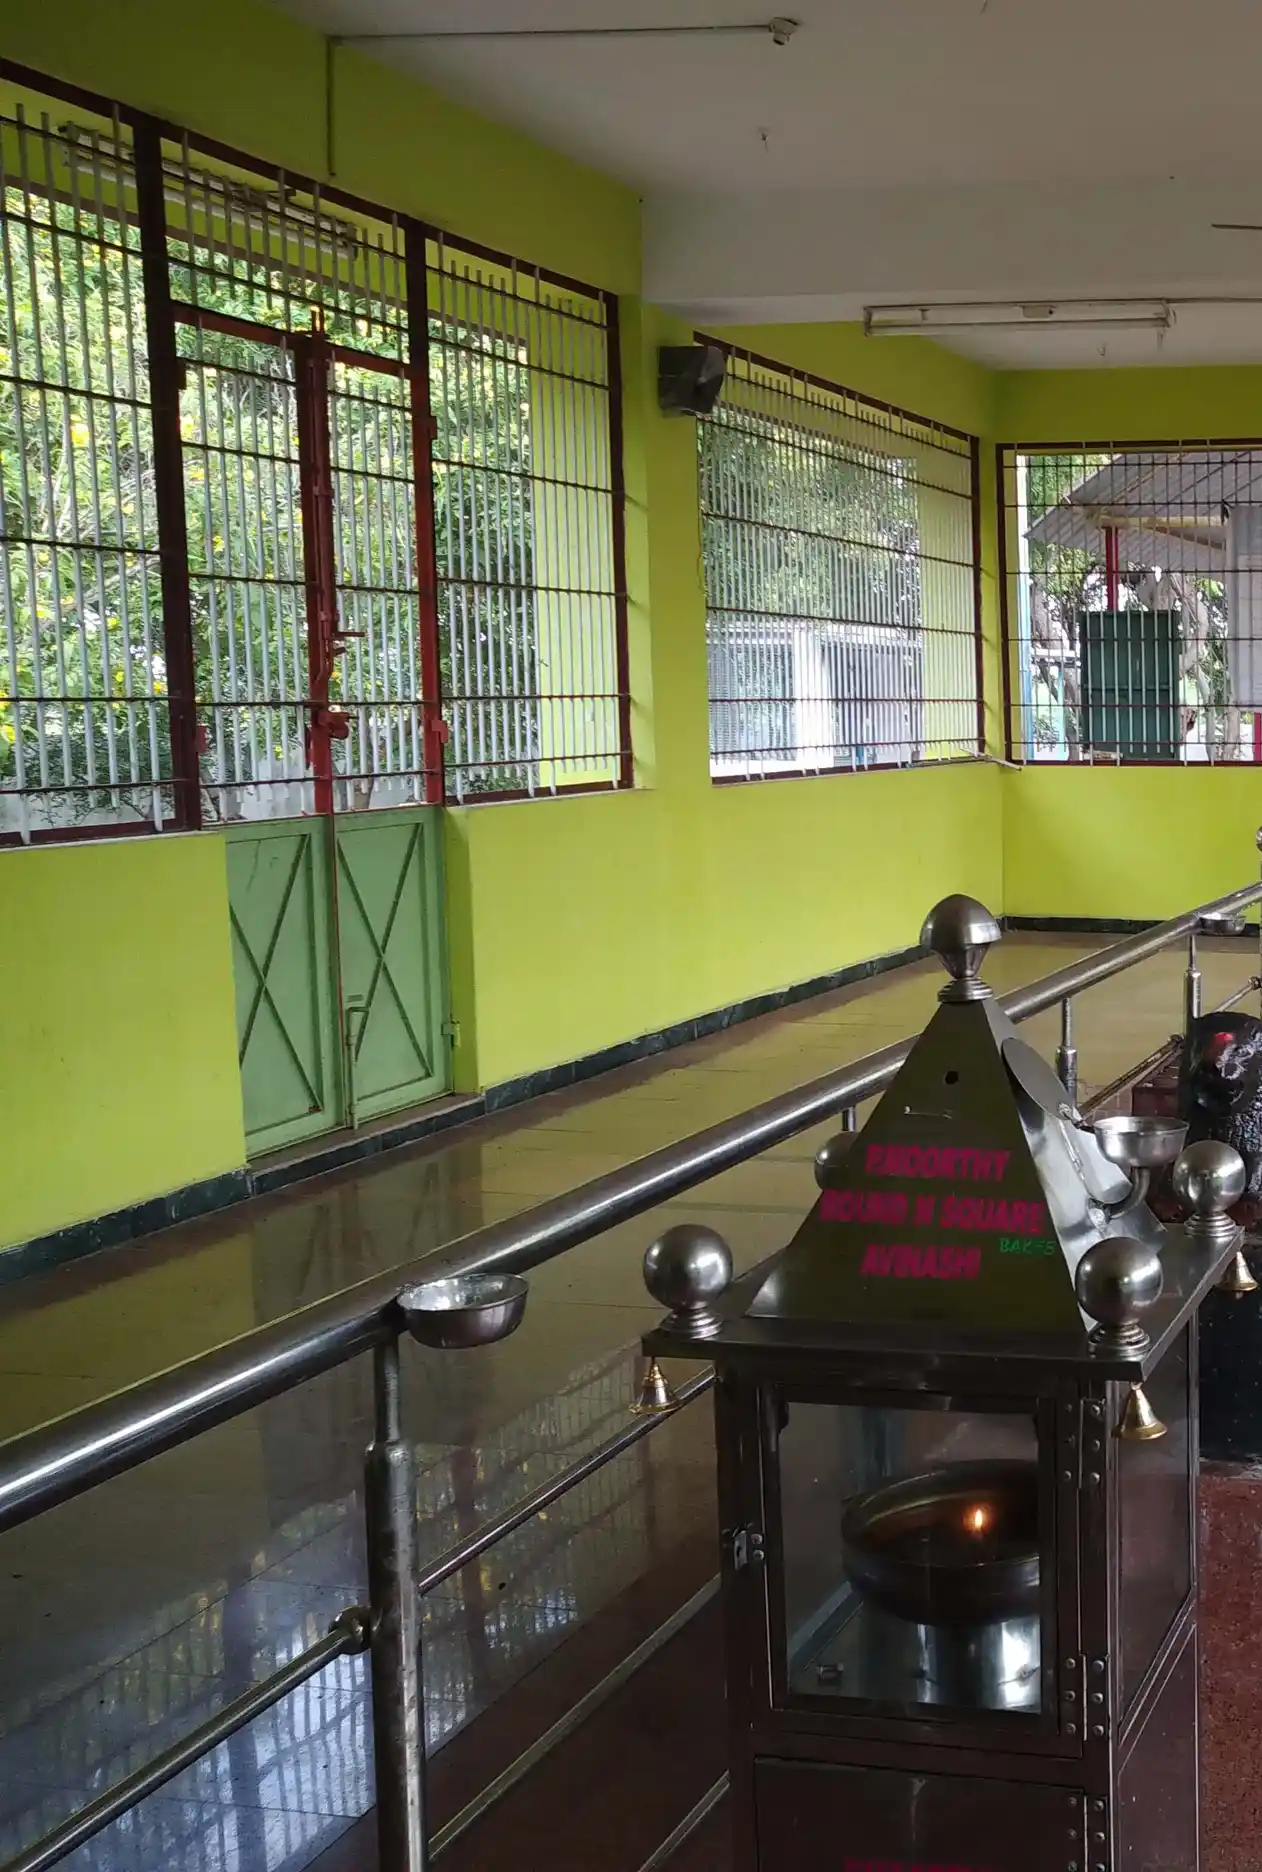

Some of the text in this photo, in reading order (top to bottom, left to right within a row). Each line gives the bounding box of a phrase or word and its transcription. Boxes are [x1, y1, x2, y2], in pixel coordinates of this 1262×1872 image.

[819, 1188, 1047, 1235] ROUND N SQUARE
[860, 1243, 981, 1280] AVINASHI
